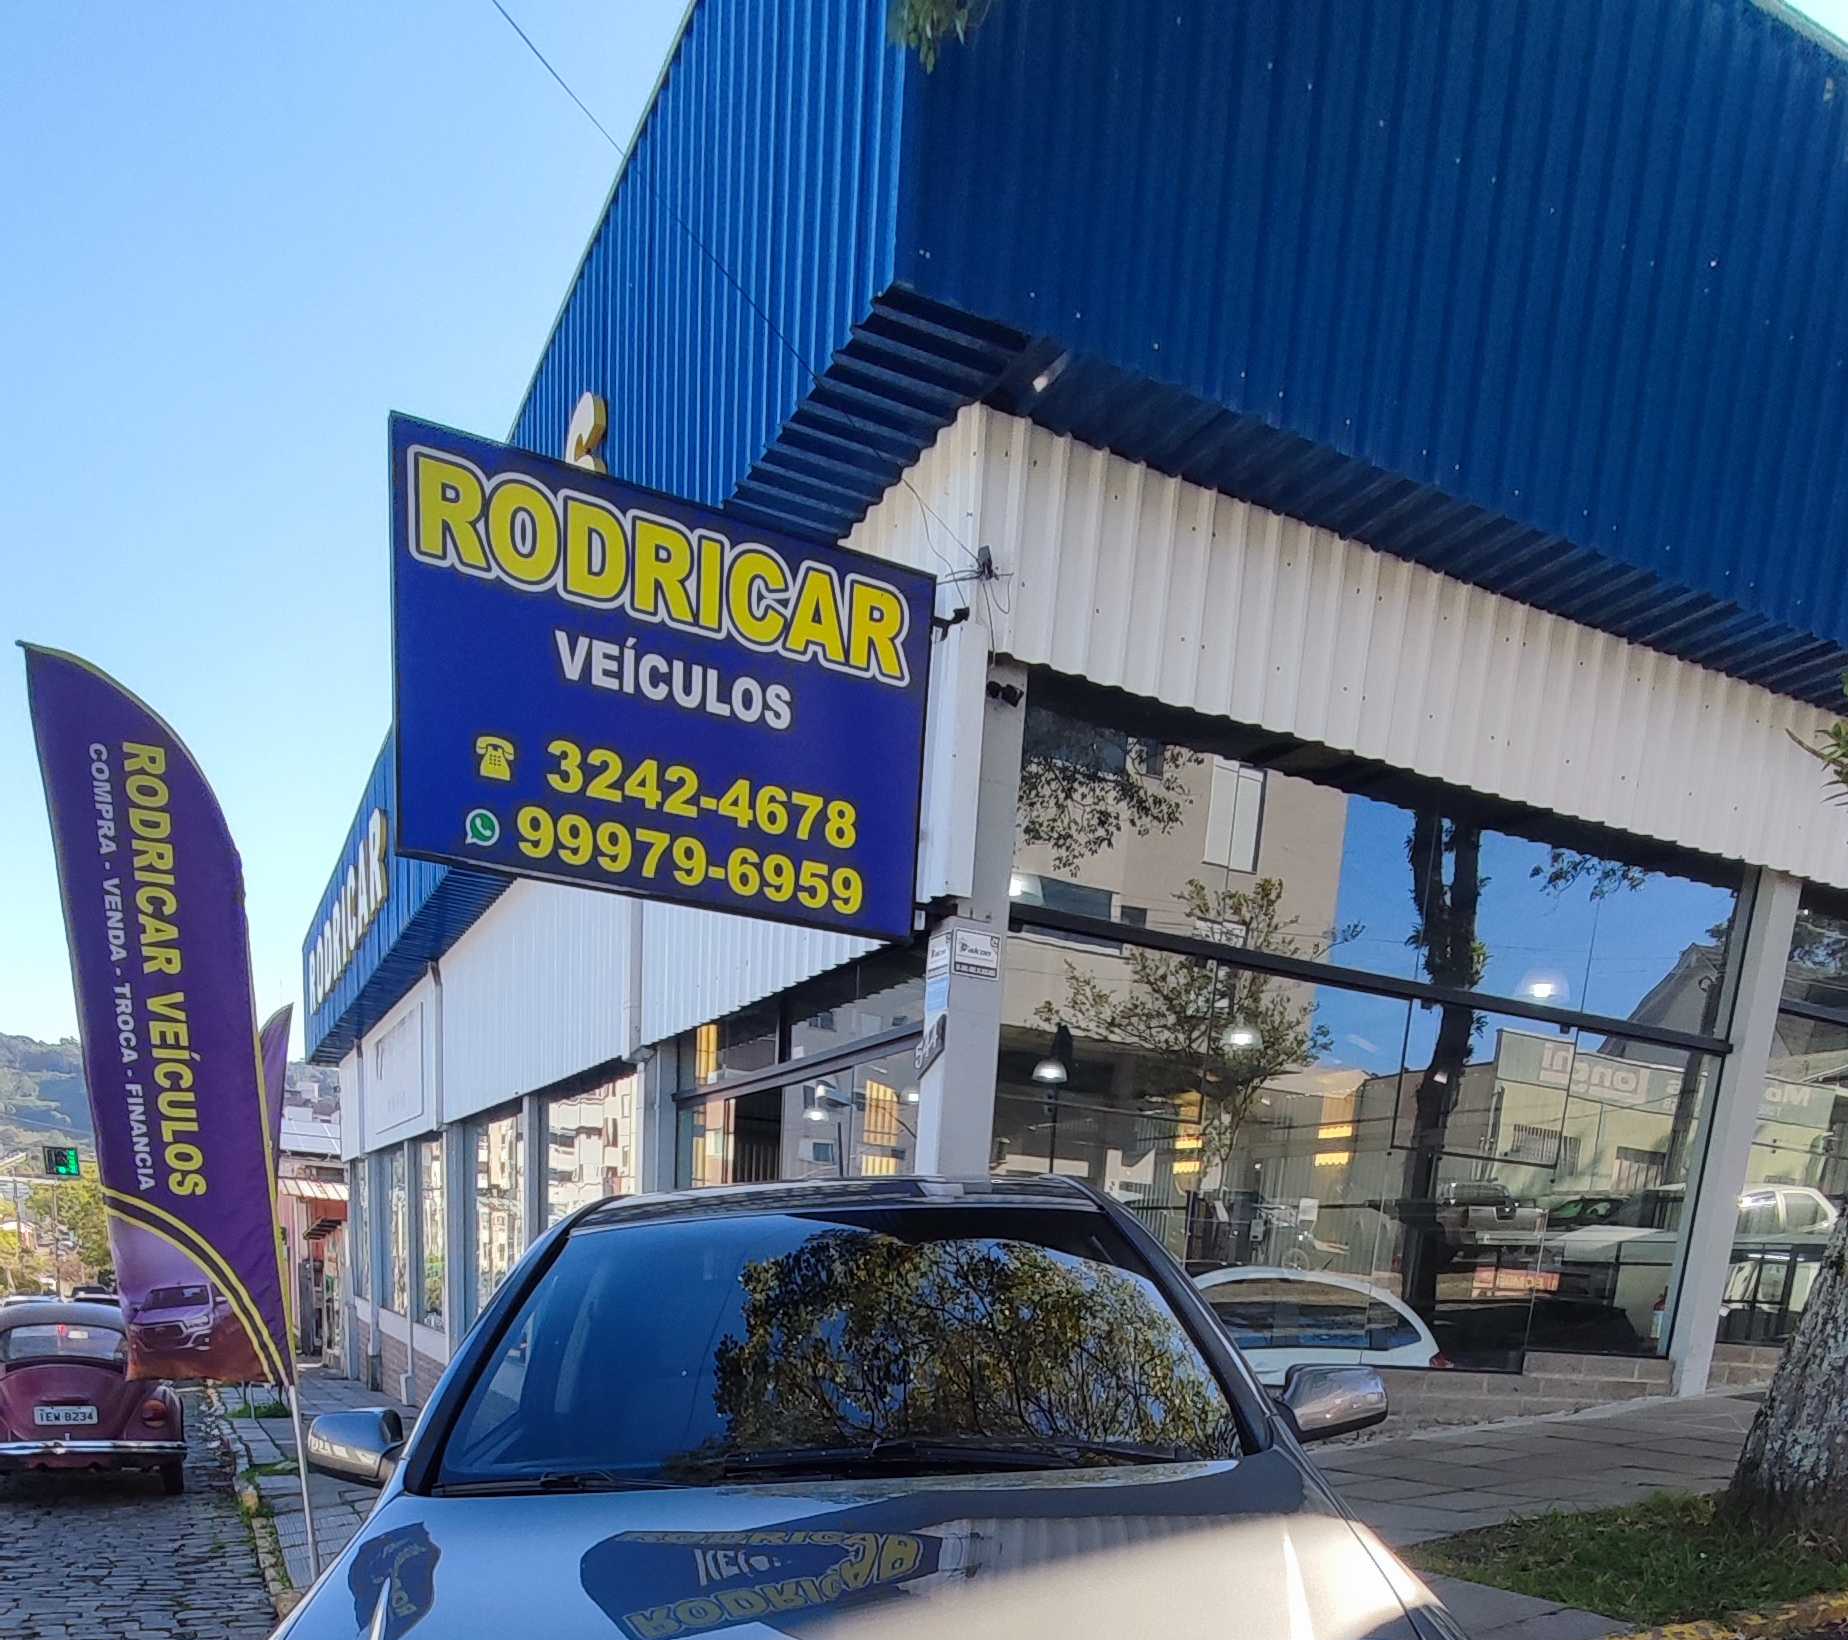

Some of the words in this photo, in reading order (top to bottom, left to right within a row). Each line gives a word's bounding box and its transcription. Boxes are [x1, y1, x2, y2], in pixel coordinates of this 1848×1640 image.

[408, 445, 909, 687] RODRICAR
[555, 630, 792, 729] VEÍCULOS
[89, 742, 117, 854] COMPRA
[546, 740, 857, 848] 3242-4678
[122, 741, 182, 975] RODRICAR
[308, 806, 388, 1016] RODRICAR
[517, 806, 863, 914] 99979-6959
[103, 877, 127, 961] VENDA
[113, 983, 138, 1064] TROCA
[125, 1083, 155, 1191] FINANCIA
[146, 992, 207, 1196] VEÍCULOS
